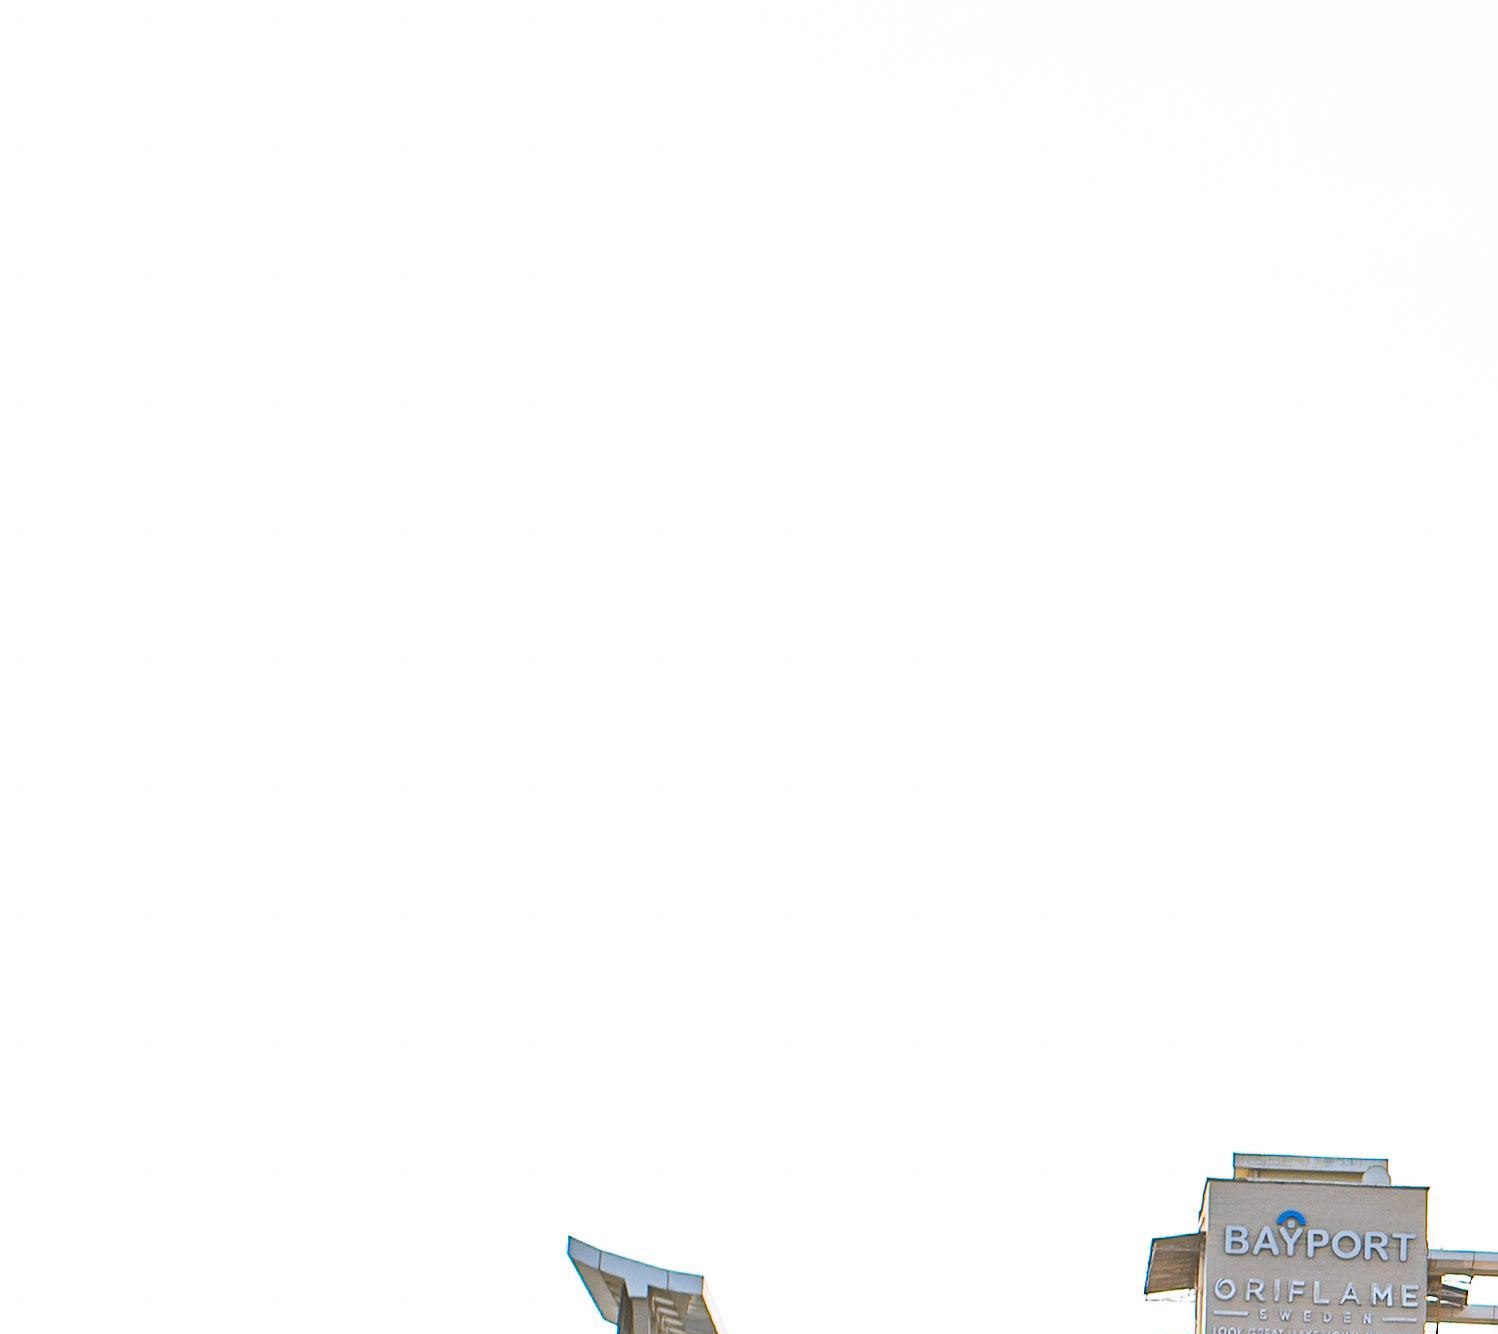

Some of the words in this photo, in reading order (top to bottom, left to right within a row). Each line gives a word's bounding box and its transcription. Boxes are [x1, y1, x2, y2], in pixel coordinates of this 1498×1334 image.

[1225, 1225, 1416, 1262] BAYPORT
[1214, 1278, 1419, 1308] ORIFLAME
[1259, 1309, 1372, 1324] SWEDEN
